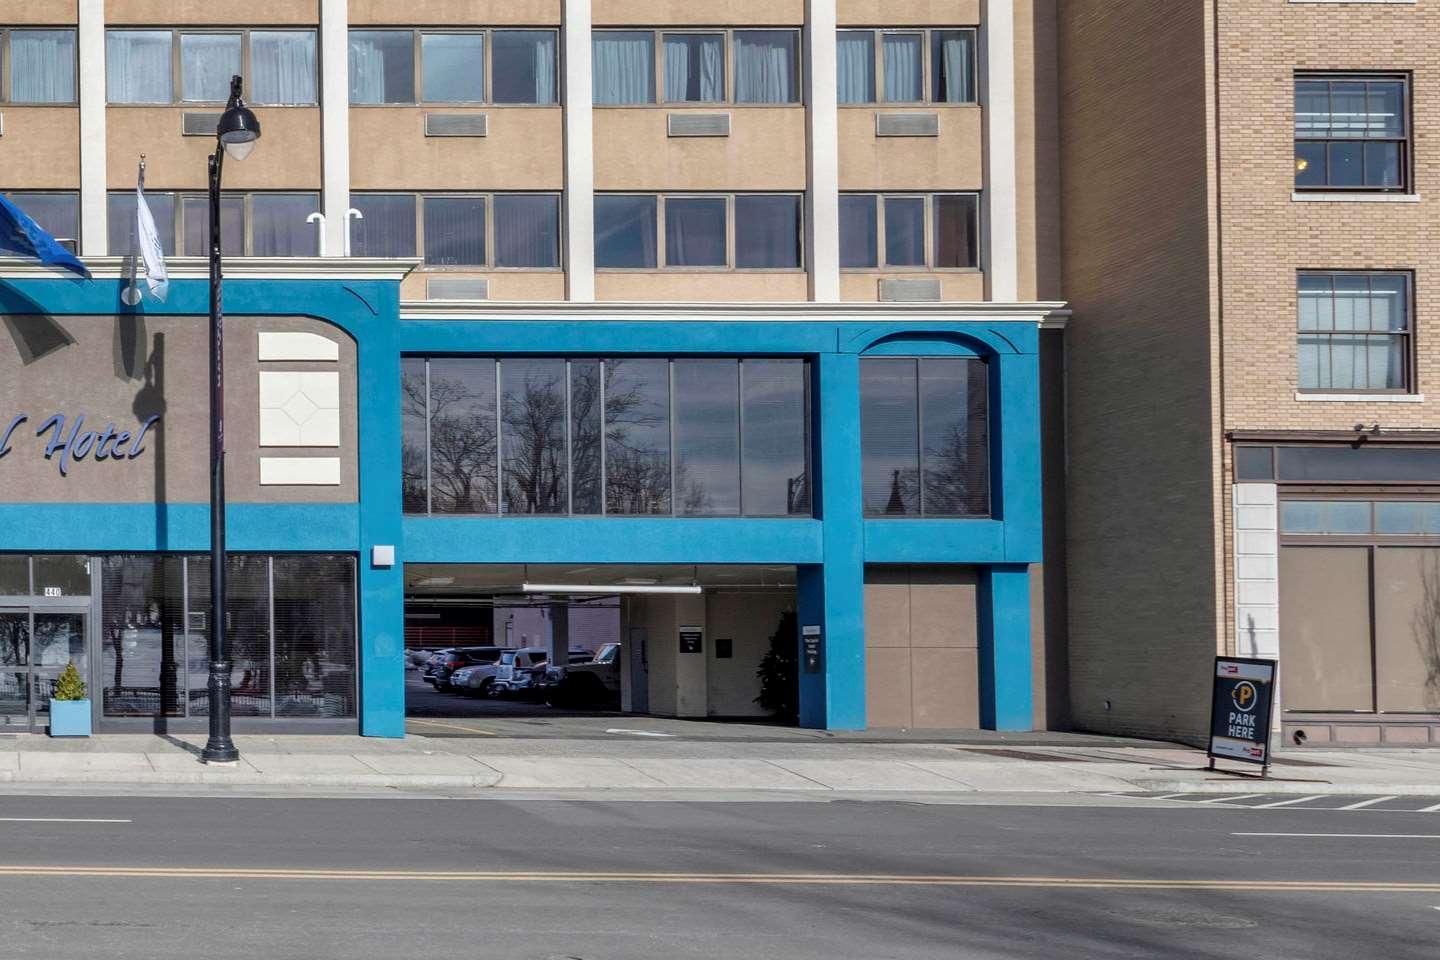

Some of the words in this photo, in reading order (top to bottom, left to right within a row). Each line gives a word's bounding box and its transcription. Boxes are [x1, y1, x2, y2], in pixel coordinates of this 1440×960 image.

[36, 413, 161, 478] Hotel
[1229, 711, 1257, 727] PARK
[1228, 724, 1256, 740] HERE
